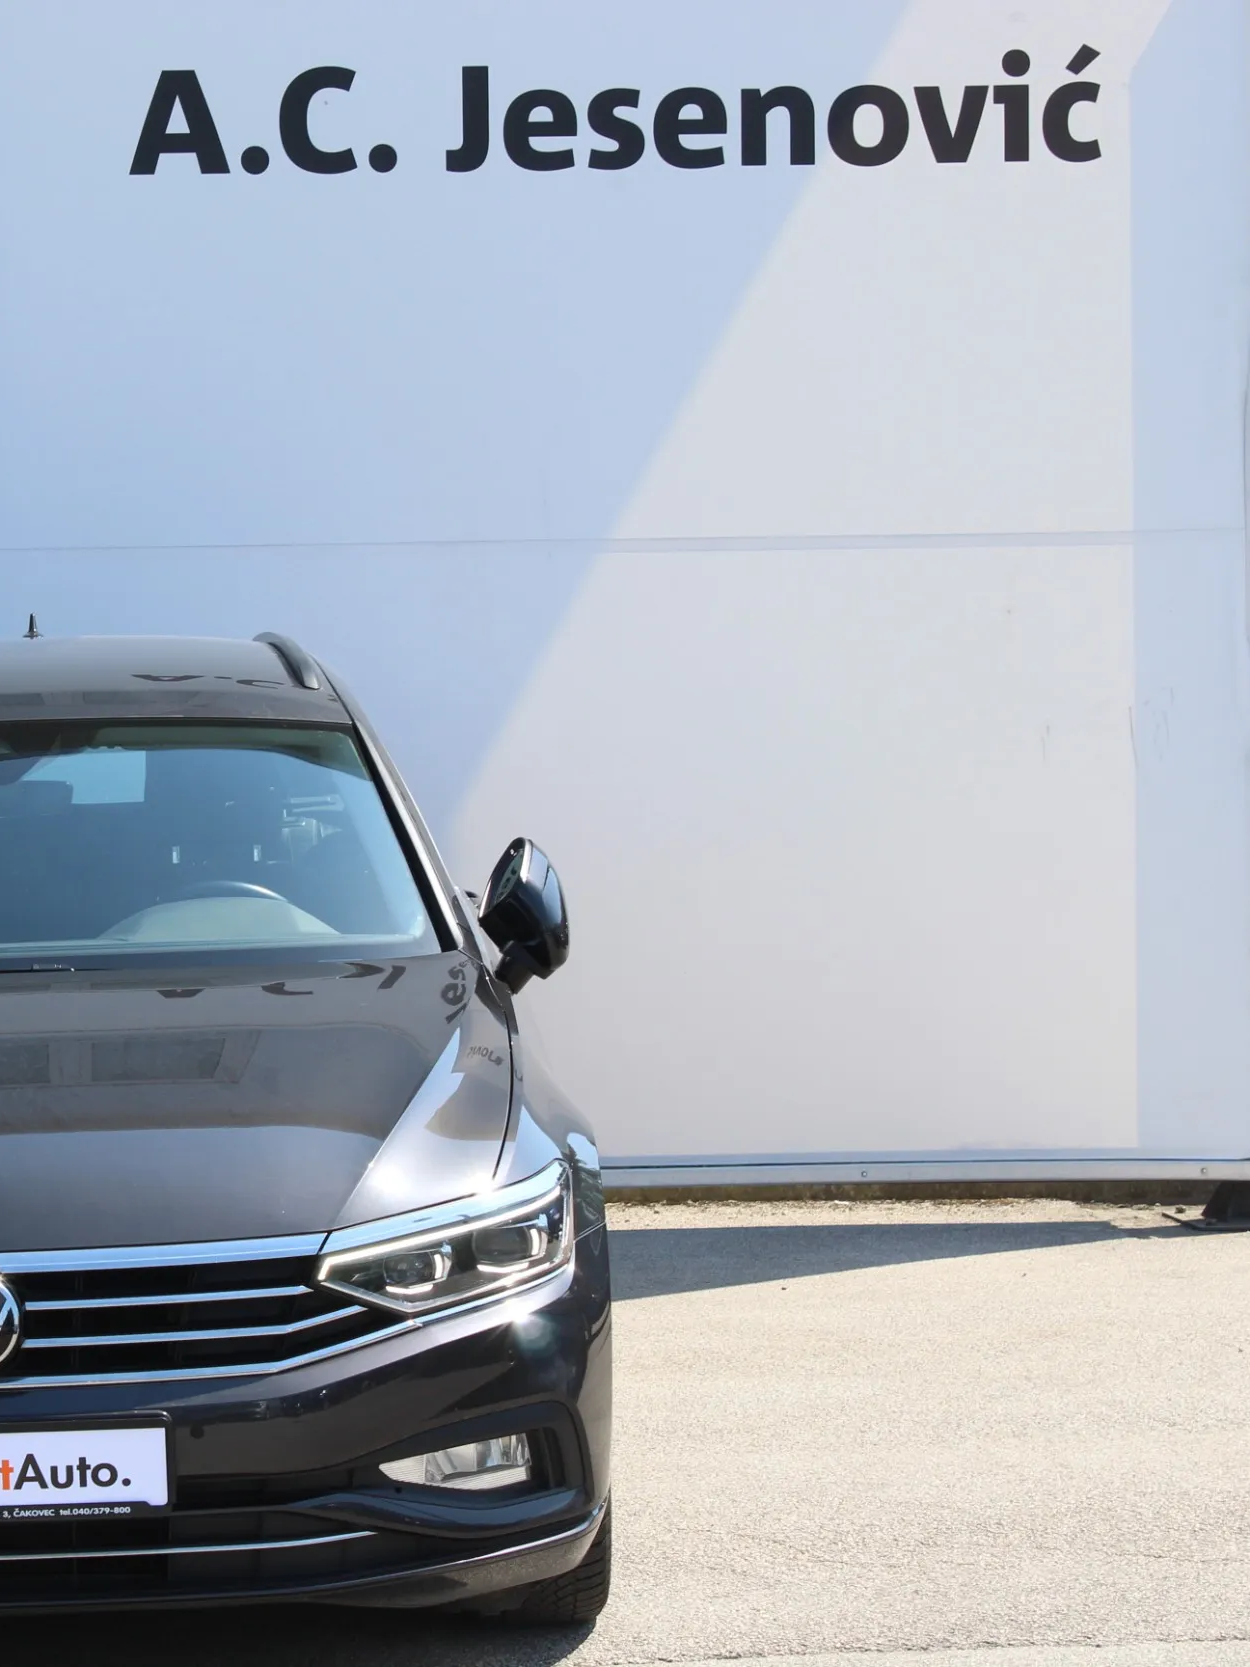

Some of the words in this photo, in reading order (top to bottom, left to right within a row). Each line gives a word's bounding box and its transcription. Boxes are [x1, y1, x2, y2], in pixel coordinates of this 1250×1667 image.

[130, 66, 398, 175] A.C.
[445, 44, 1102, 172] Jesenović
[13, 1508, 55, 1517] ČAKOVEC
